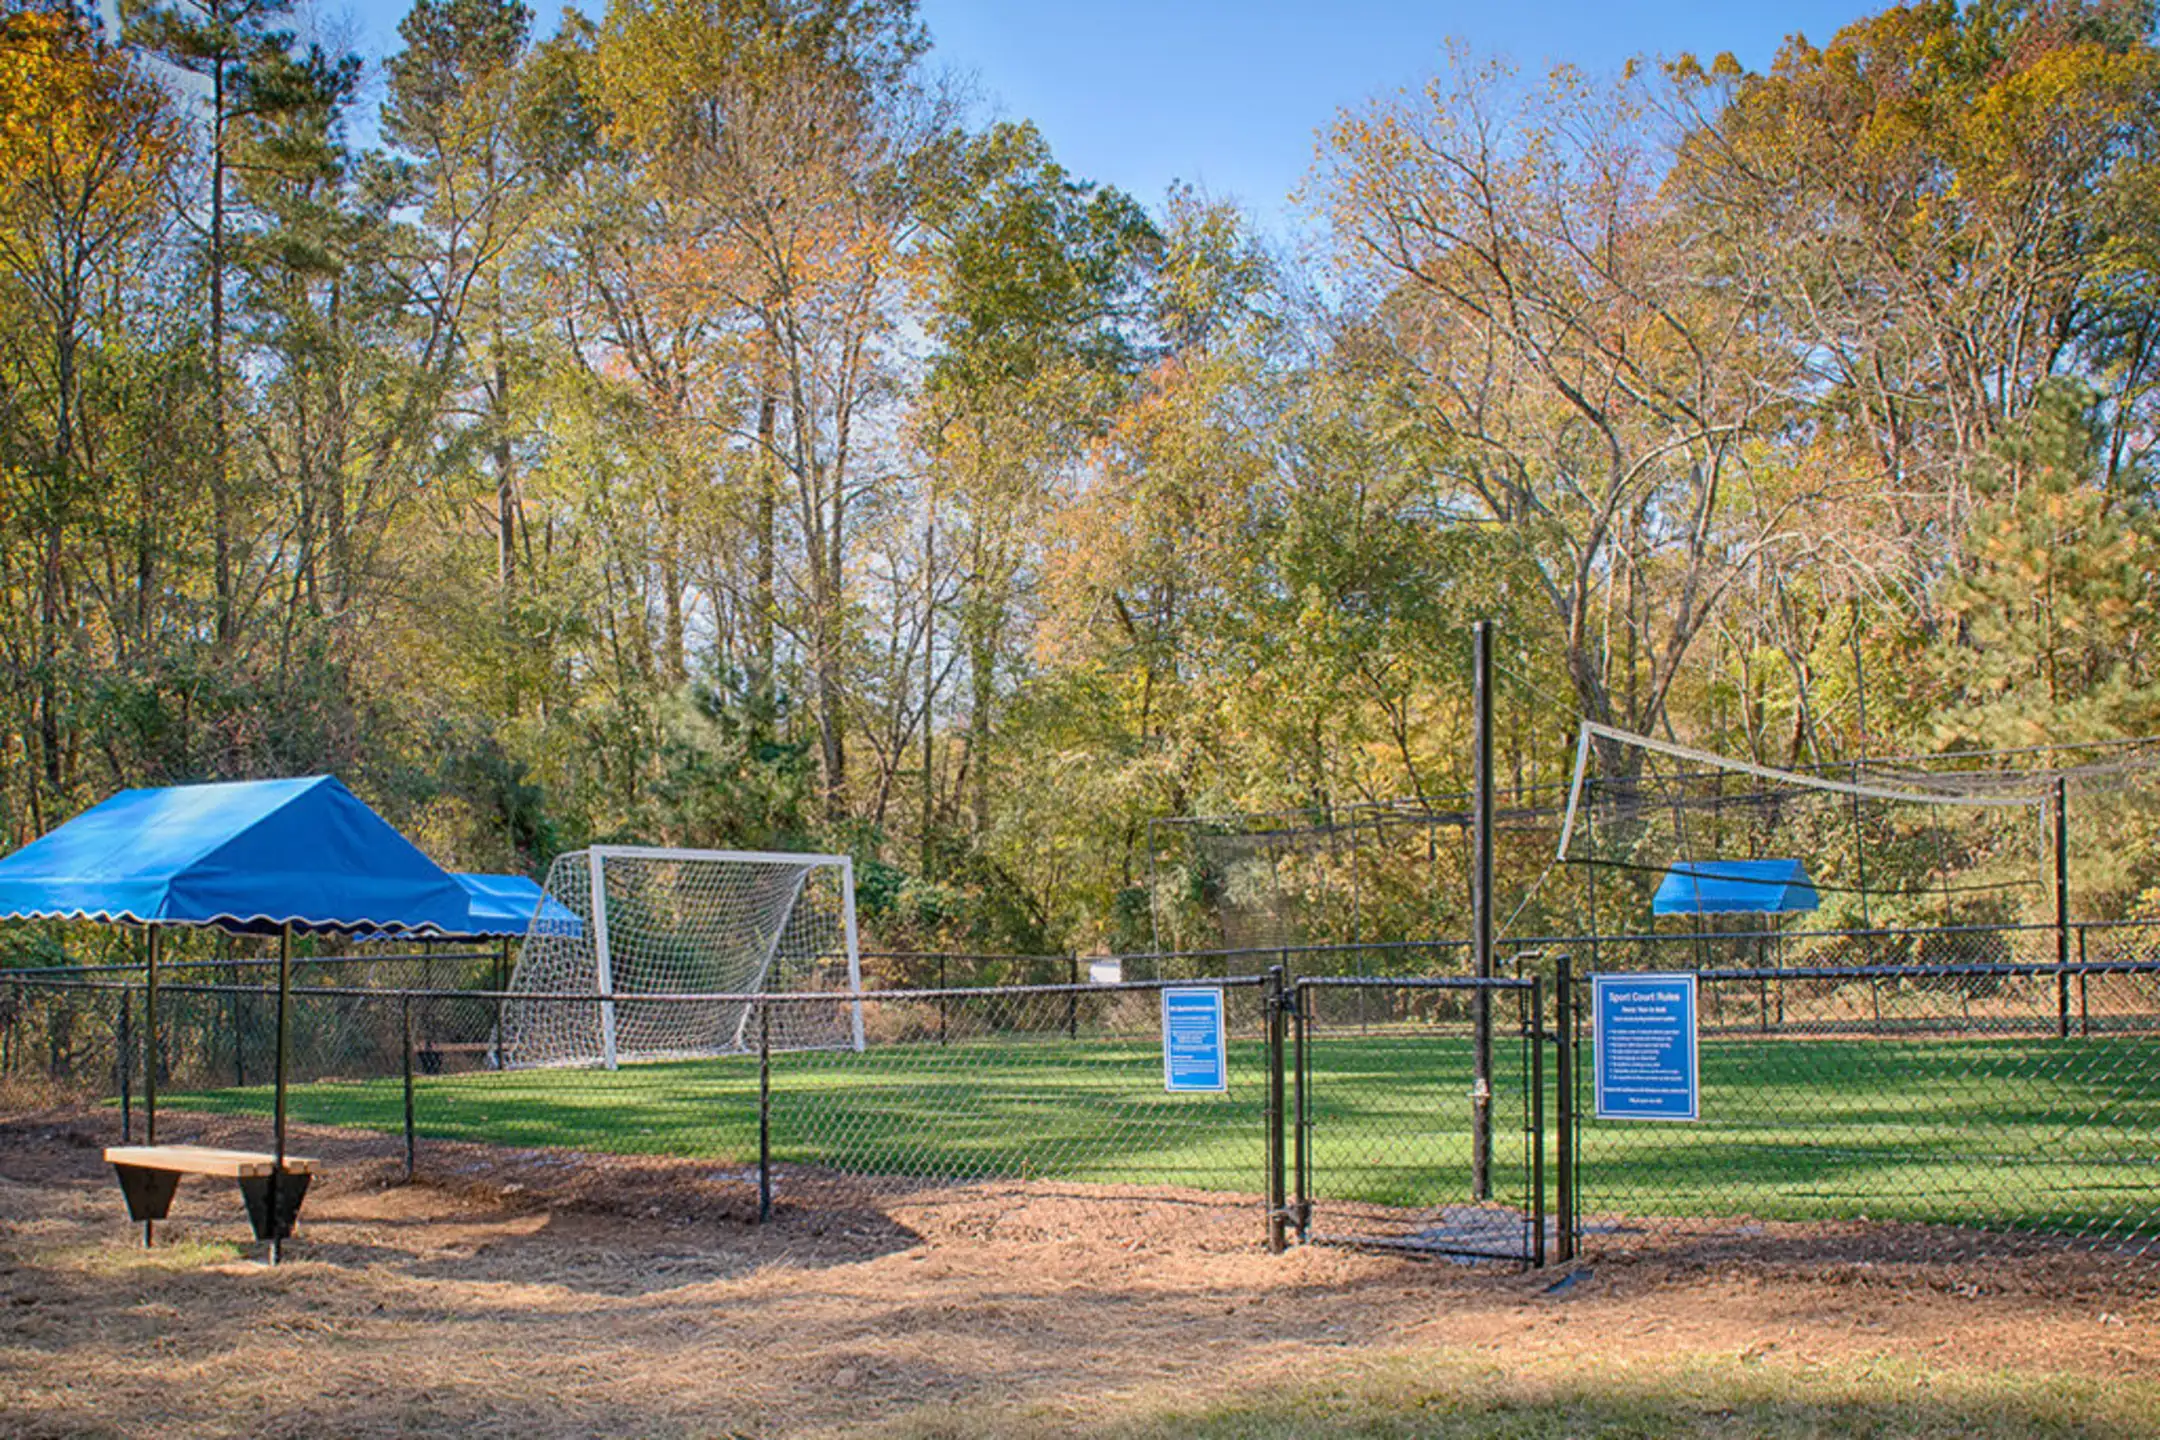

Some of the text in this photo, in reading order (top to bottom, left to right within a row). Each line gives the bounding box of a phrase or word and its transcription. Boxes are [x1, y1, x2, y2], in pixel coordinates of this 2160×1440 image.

[1609, 992, 1680, 1003] Sport Court Rules
